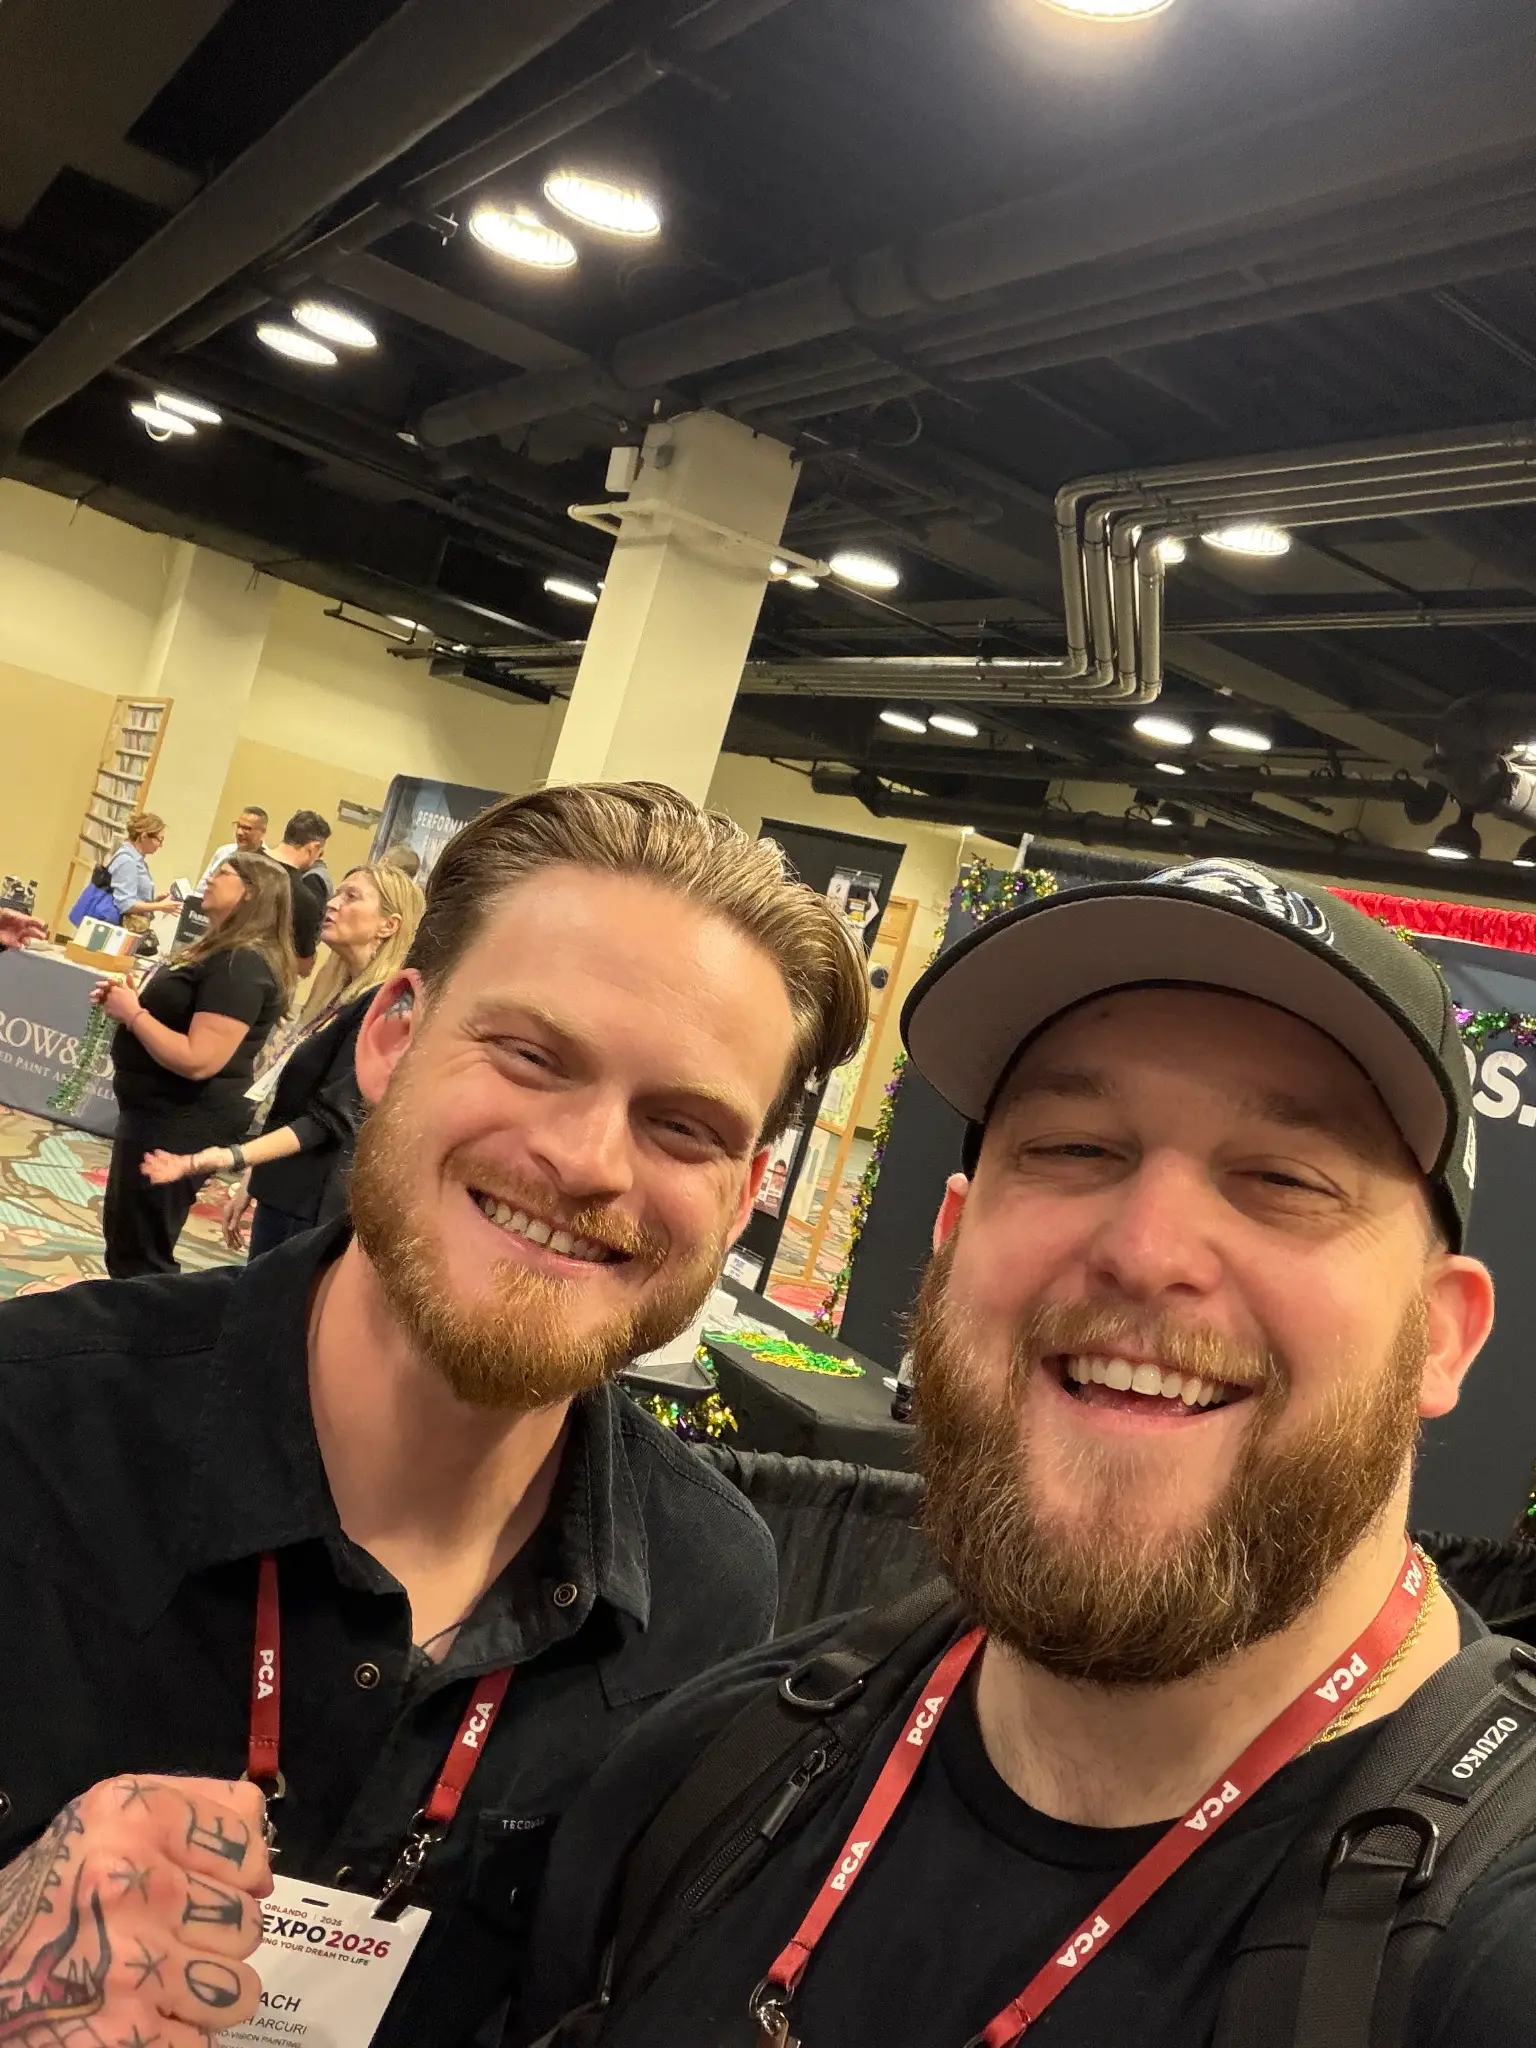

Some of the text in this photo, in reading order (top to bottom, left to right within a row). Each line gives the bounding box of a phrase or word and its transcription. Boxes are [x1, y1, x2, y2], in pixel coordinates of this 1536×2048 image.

[257, 1650, 274, 1699] PCA
[1314, 1652, 1368, 1703] PCA
[462, 1702, 493, 1748] PCA
[906, 1696, 944, 1746] PCA
[1451, 1717, 1518, 1779] OZUKO
[1184, 1780, 1241, 1831] PCA
[830, 1841, 870, 1890] PCA
[264, 1903, 308, 1919] ORLANDO
[280, 1940, 304, 1953] YOUR
[305, 1946, 336, 1960] DREAM
[338, 1953, 349, 1962] TO
[350, 1957, 369, 1966] LIFE
[1056, 1915, 1110, 1967] PCA
[255, 2017, 308, 2035] ARCURI
